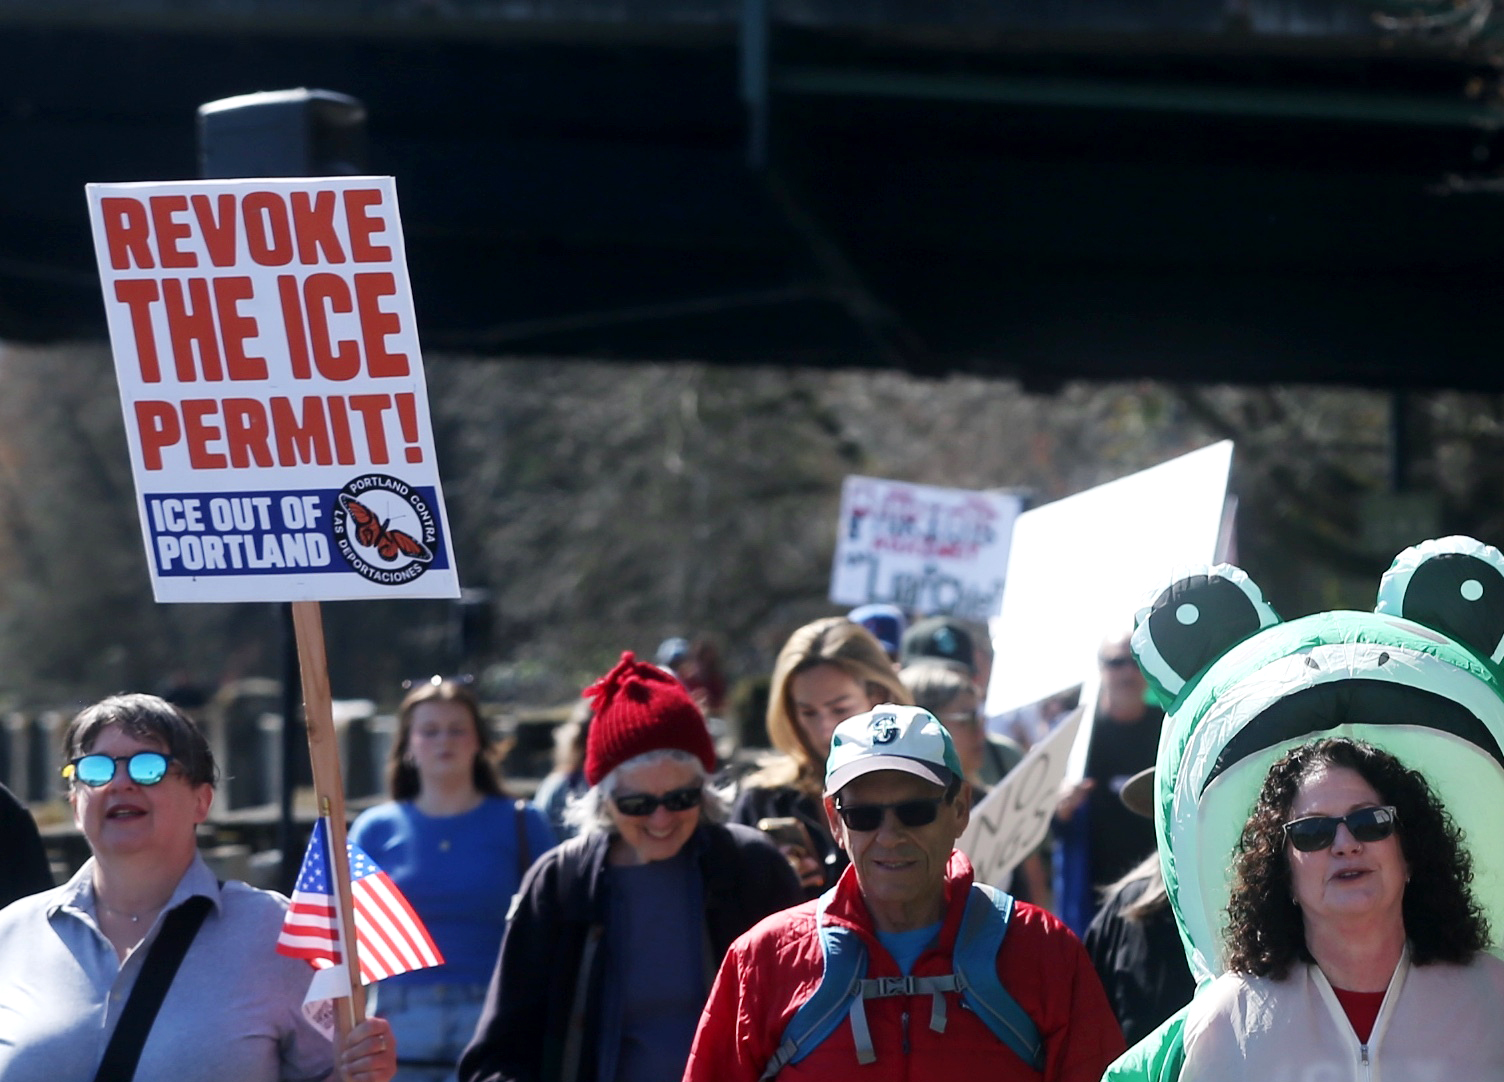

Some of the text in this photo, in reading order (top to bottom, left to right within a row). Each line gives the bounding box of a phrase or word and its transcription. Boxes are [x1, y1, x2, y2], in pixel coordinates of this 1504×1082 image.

[101, 188, 392, 271] REVOKE
[113, 272, 410, 383] THE ICE
[134, 392, 424, 471] PERMIT!
[150, 496, 322, 532] ICE OUT OF
[333, 510, 423, 583] LAS DEPORTACIONES
[349, 476, 436, 543] PORTLAND CONTRA
[156, 531, 331, 571] PORTLAND
[970, 752, 1050, 861] NO
